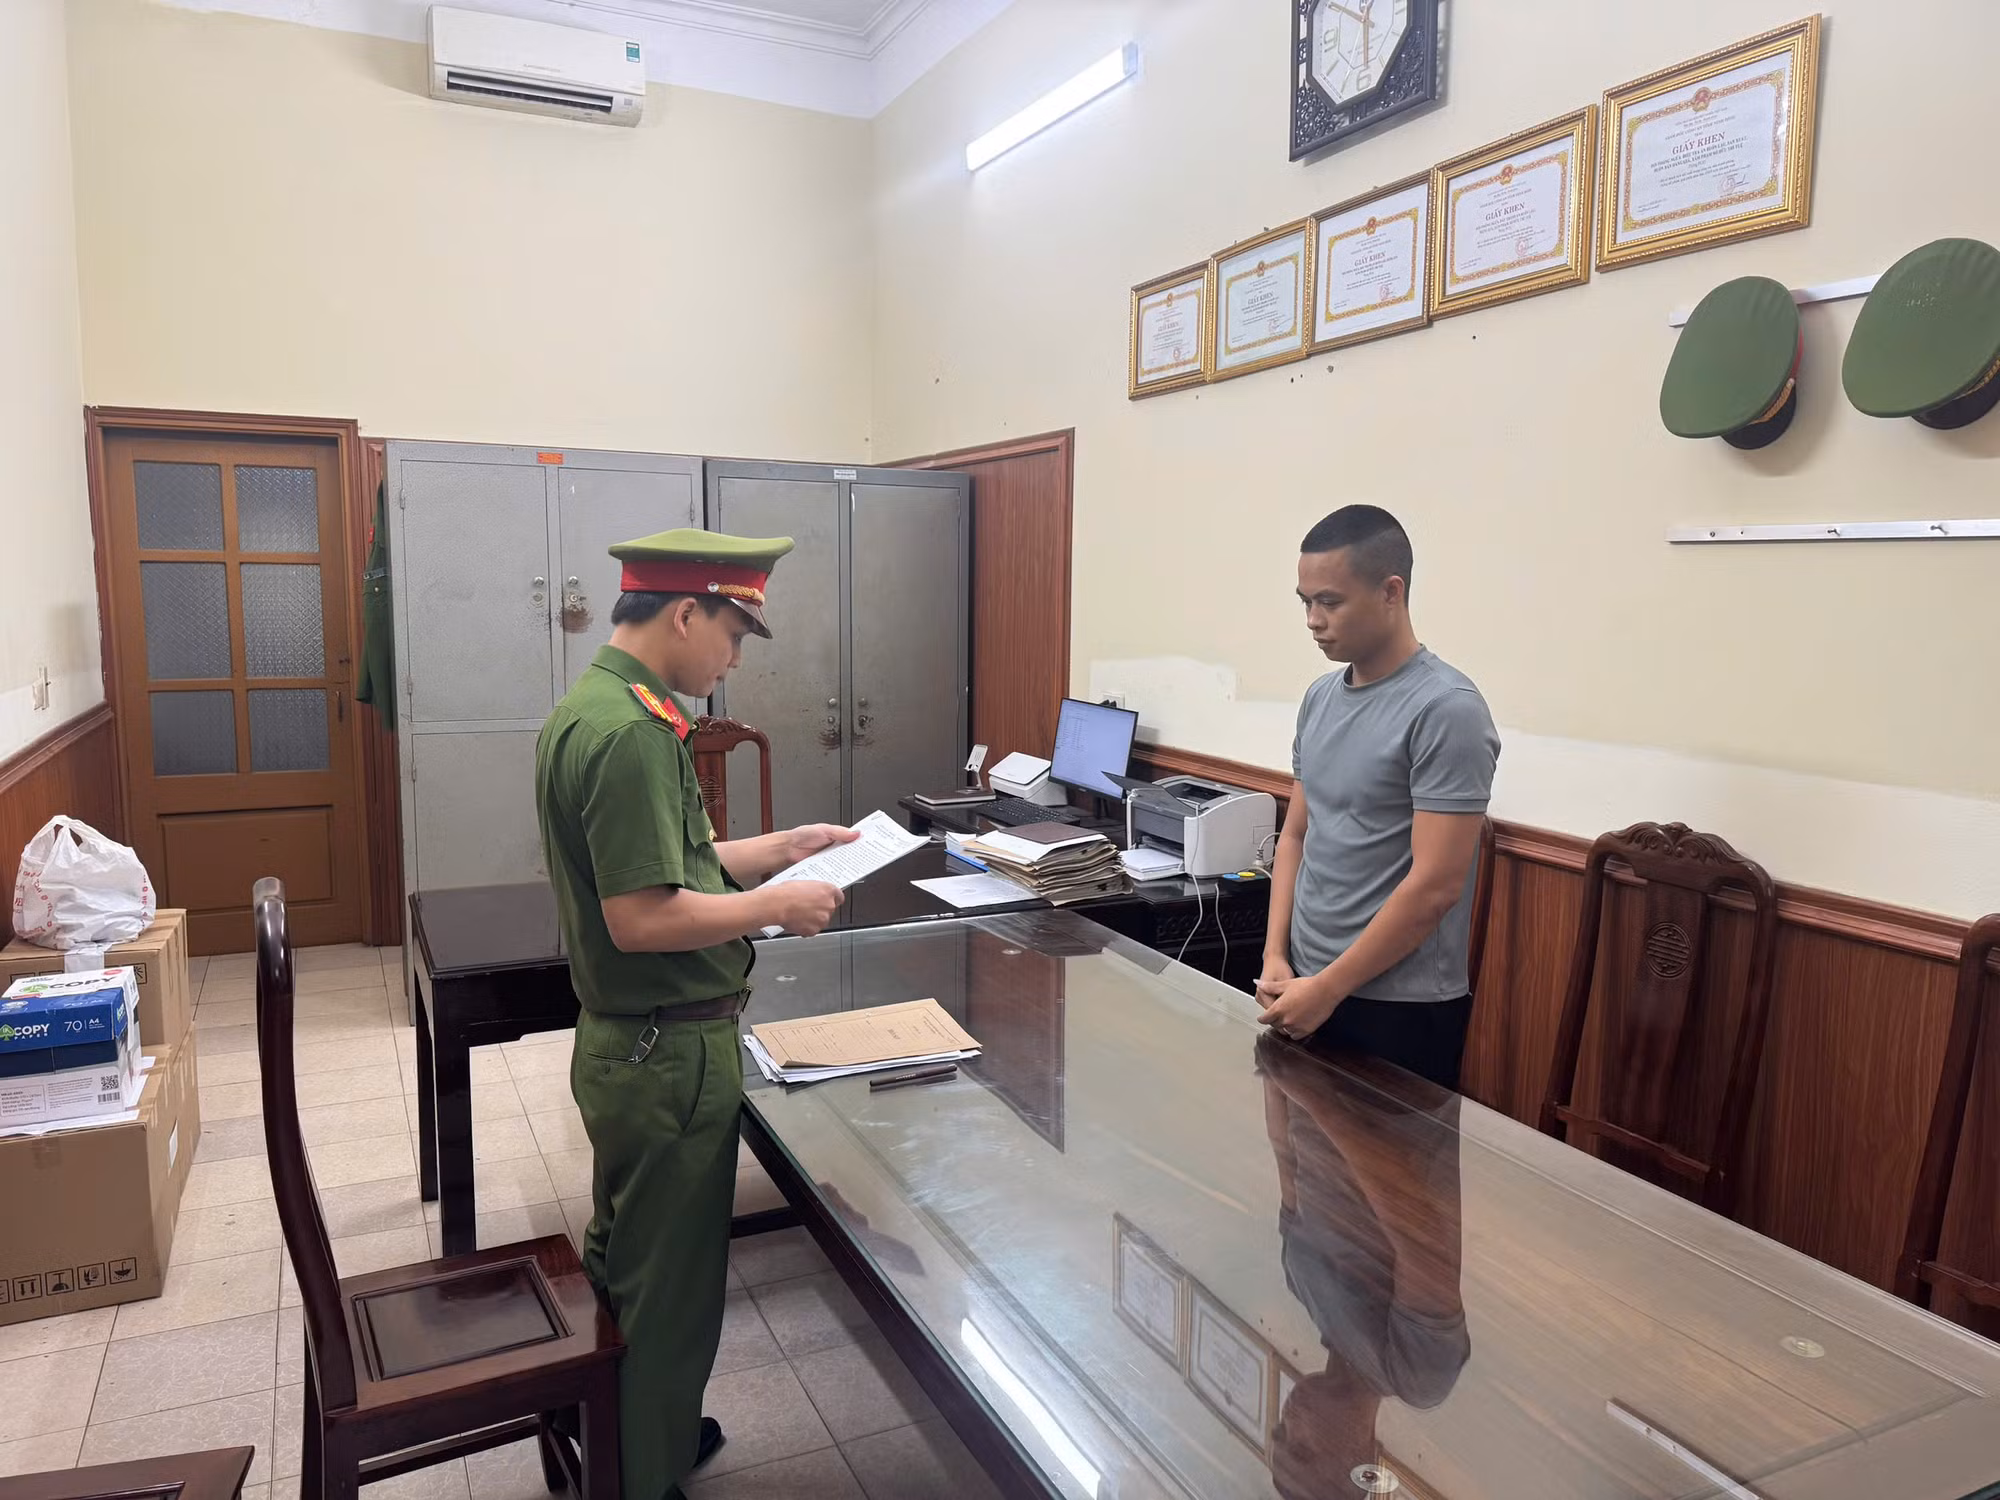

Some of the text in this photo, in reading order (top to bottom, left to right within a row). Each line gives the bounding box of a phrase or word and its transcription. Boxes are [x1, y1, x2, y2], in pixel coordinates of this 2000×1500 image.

[1672, 138, 1696, 155] GIẤY
[1697, 131, 1726, 148] KHEN
[1503, 201, 1525, 216] KHEN
[49, 976, 117, 989] COPY
[14, 1023, 50, 1036] COPY
[64, 1020, 83, 1032] 70
